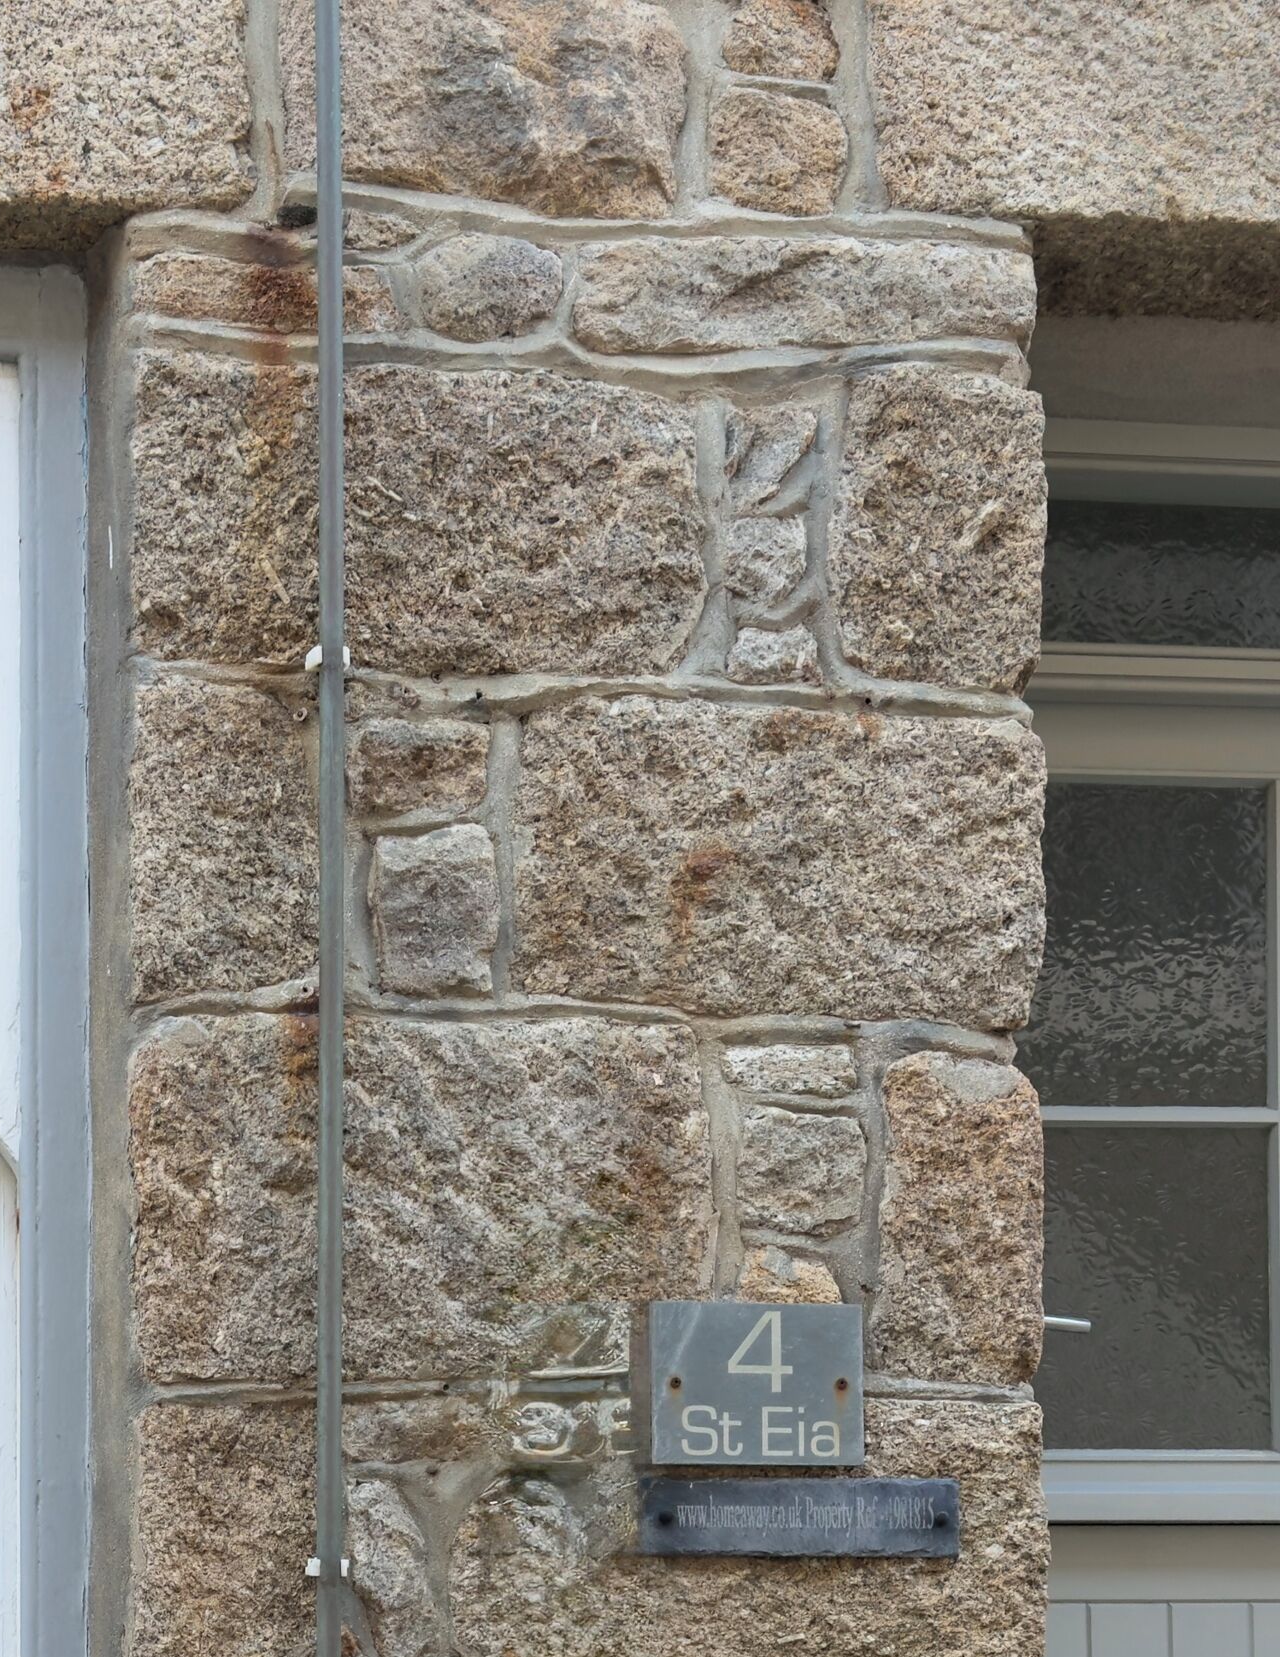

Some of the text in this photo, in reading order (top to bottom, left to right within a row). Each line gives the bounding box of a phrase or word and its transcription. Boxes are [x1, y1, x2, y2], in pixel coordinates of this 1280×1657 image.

[727, 1310, 793, 1393] 4
[680, 1404, 744, 1457] St
[761, 1406, 840, 1457] Eia
[676, 1494, 802, 1537] www.homeaway.co.uk
[805, 1496, 854, 1538] Property
[856, 1495, 879, 1529] Ref
